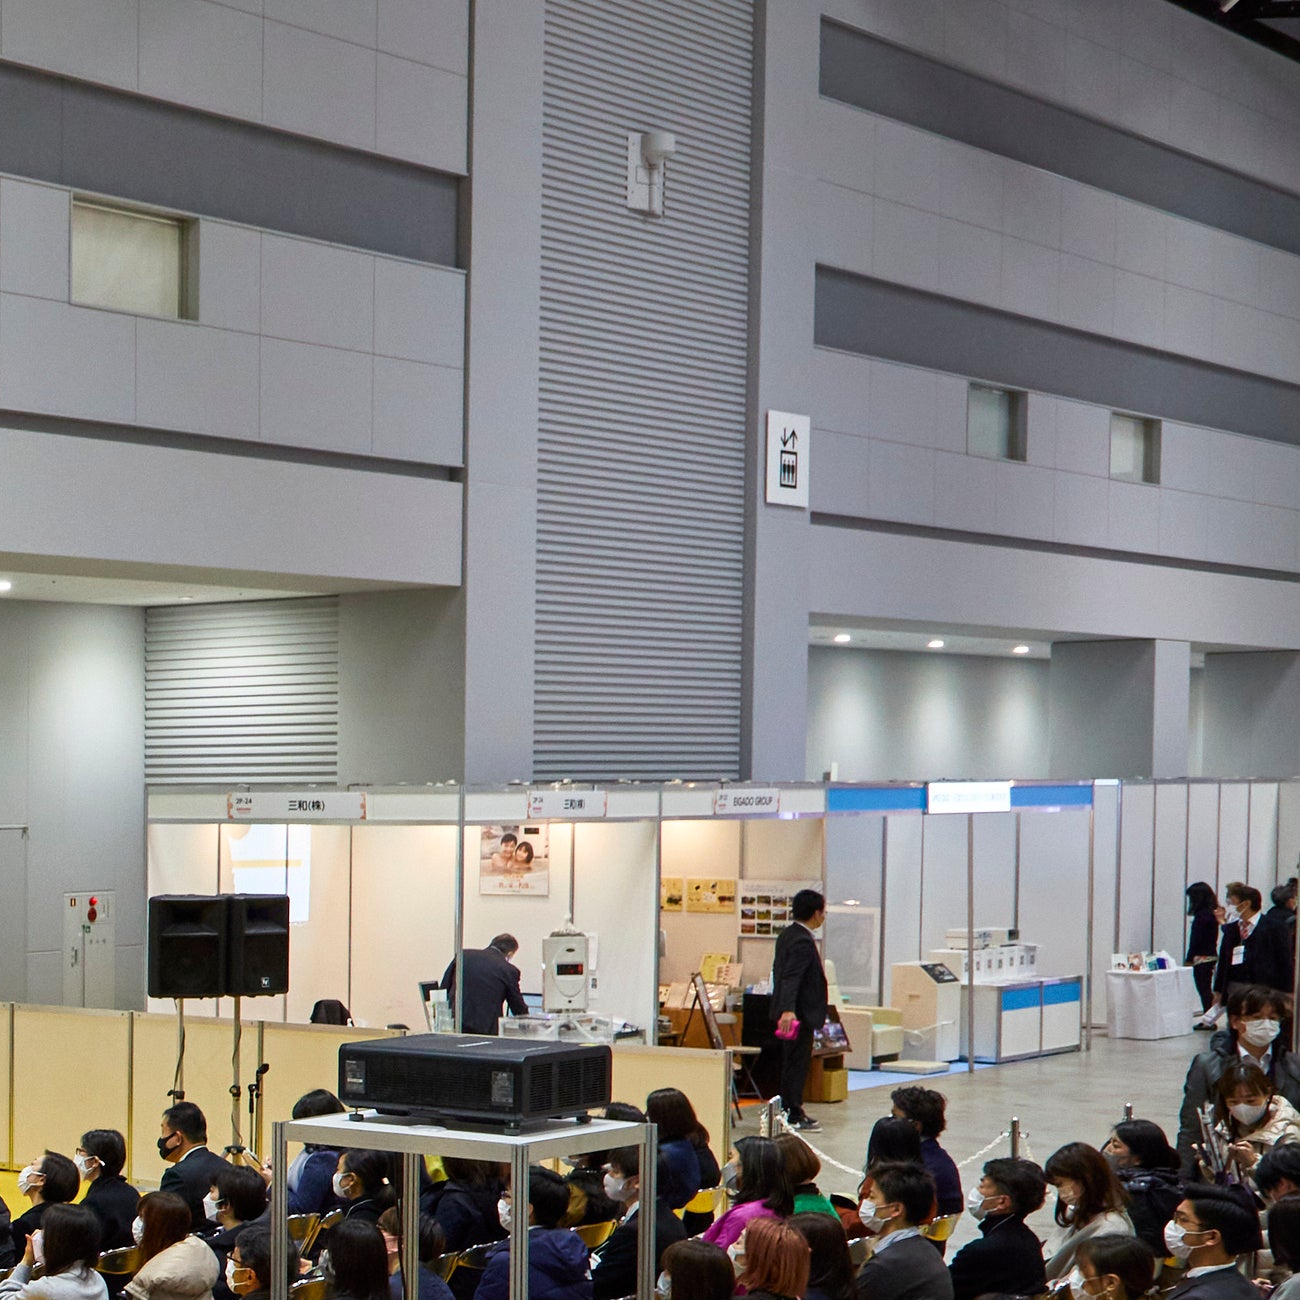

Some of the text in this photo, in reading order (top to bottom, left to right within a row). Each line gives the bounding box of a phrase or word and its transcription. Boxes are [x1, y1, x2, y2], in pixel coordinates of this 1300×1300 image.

[288, 800, 325, 811] 三和(株)
[755, 796, 773, 806] GROUP
